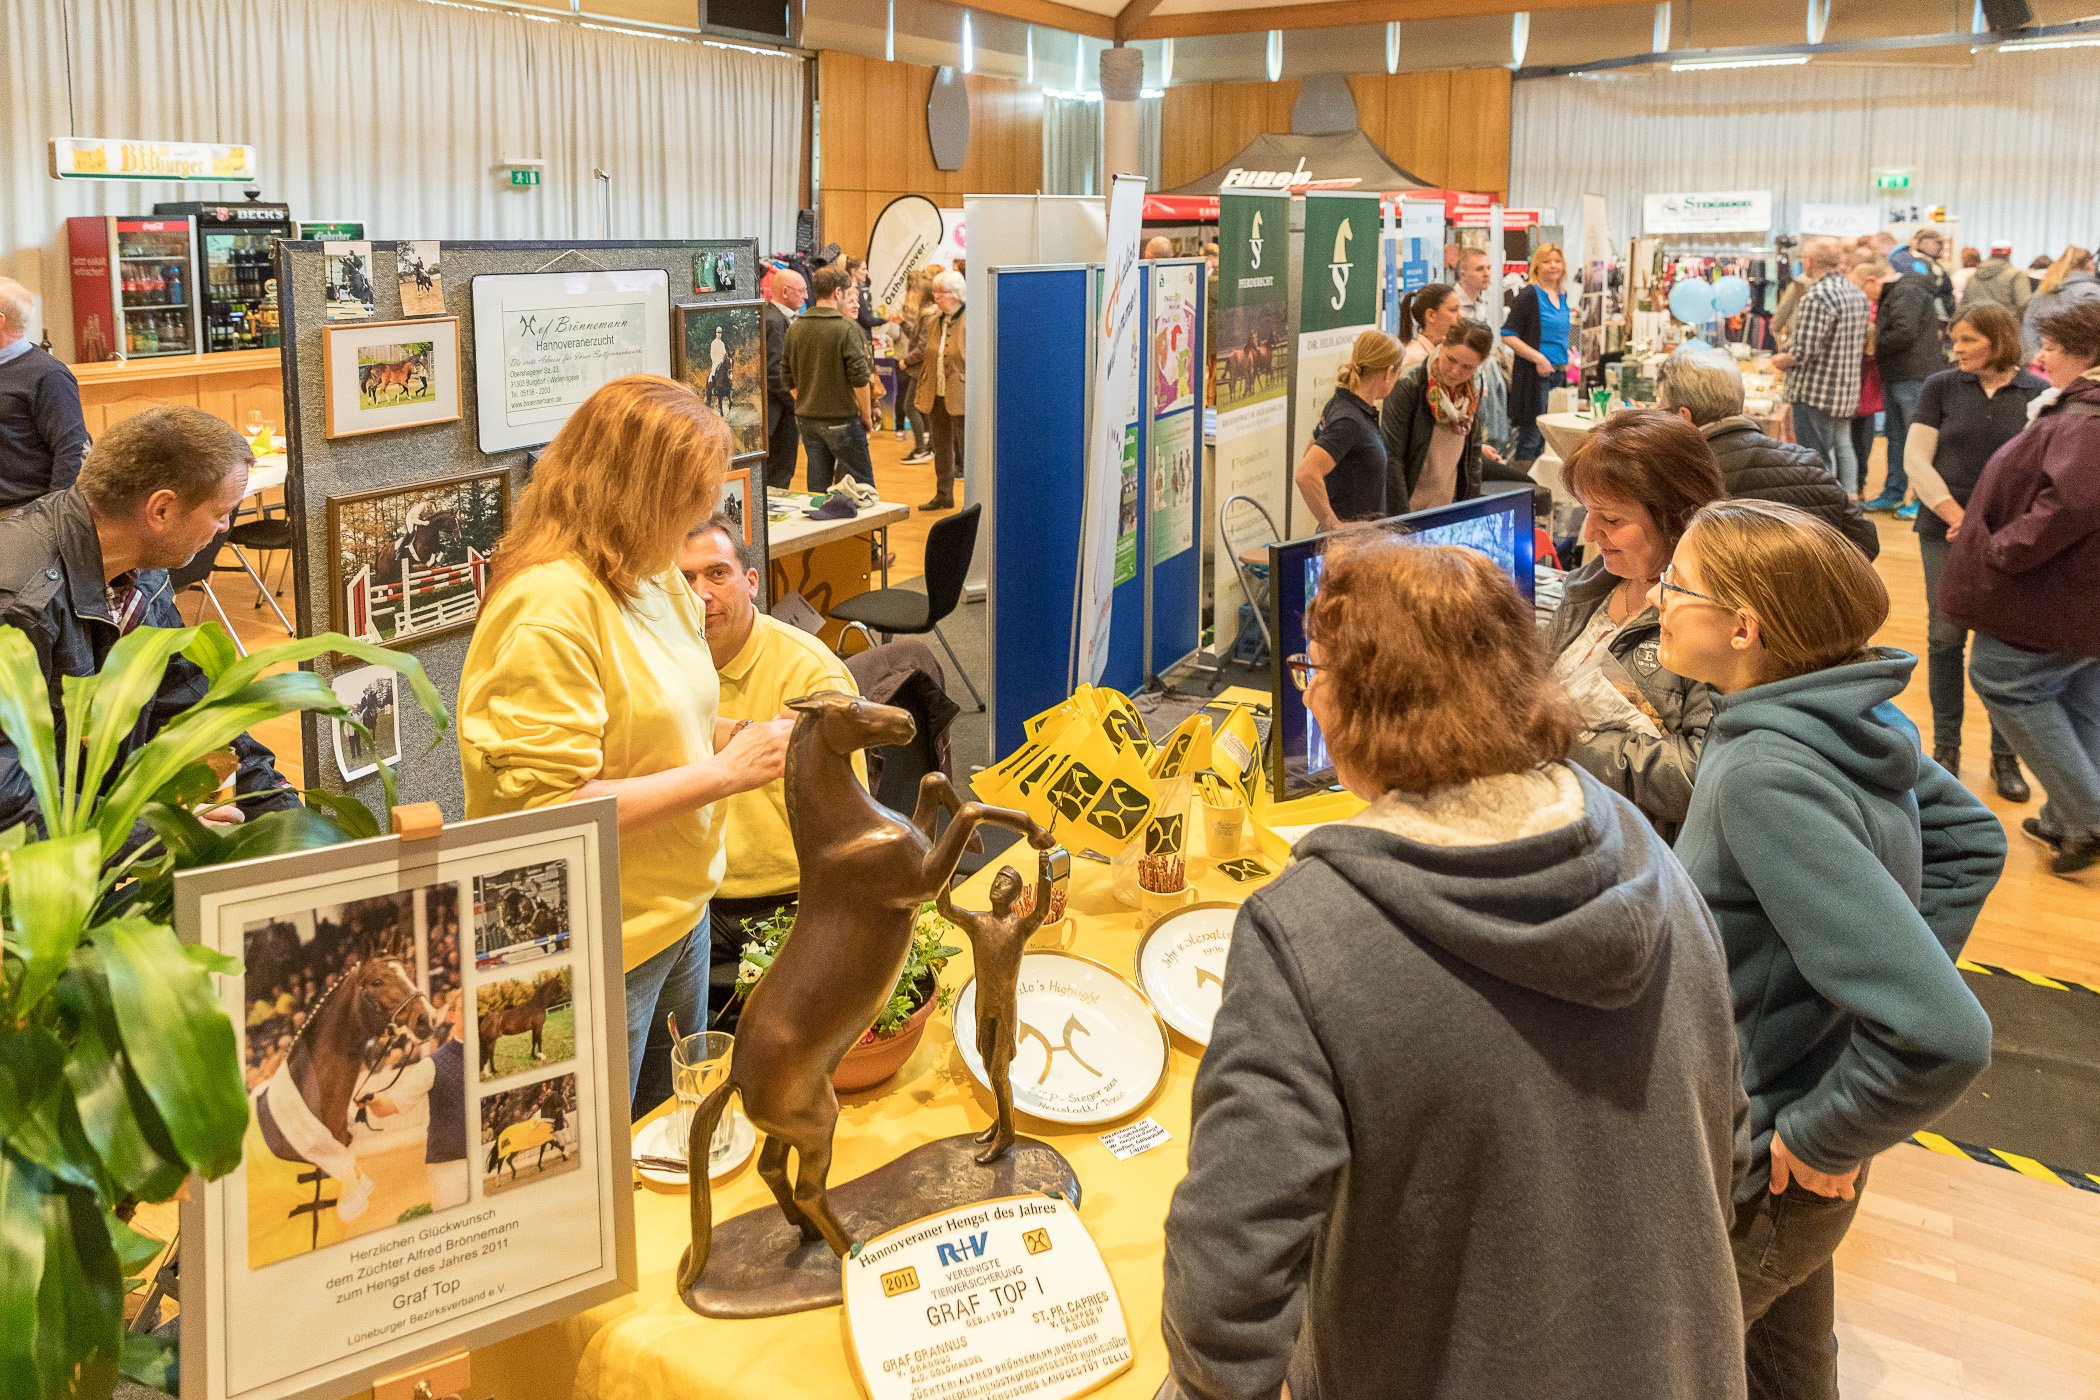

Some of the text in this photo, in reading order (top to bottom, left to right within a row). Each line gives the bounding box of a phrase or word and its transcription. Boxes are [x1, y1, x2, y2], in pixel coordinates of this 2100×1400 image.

[121, 143, 204, 178] Bitburger
[237, 209, 285, 221] BECK'S
[555, 315, 628, 333] Brönnemann
[536, 335, 615, 351] Hannoveranerzucht
[1643, 650, 1655, 662] E
[349, 1208, 496, 1264] Herzlichen Glückwunsch
[858, 1201, 1057, 1268] Hannoveraner Hengst des Jahres
[936, 1231, 988, 1267] R+V
[325, 1219, 519, 1290] dem Züchter Alfred Brönnemann
[336, 1237, 509, 1305] zum Hengst des Jahres 2011
[946, 1258, 1001, 1282] VEREINIGTE
[393, 1279, 461, 1310] Graf Top
[886, 1272, 915, 1292] 2011
[931, 1265, 1023, 1299] TIERVERSICHERUNG
[348, 1283, 507, 1347] Lüneburger Bezirksverband e.V.
[926, 1276, 1044, 1327] GRAF TOP I
[1067, 1290, 1109, 1314] CAPRIES
[882, 1335, 968, 1373] GRAF GRANNUS
[1042, 1358, 1100, 1387] LANDGESTÜT
[1102, 1350, 1130, 1366] CELLE
[959, 1367, 993, 1386] ALFRED
